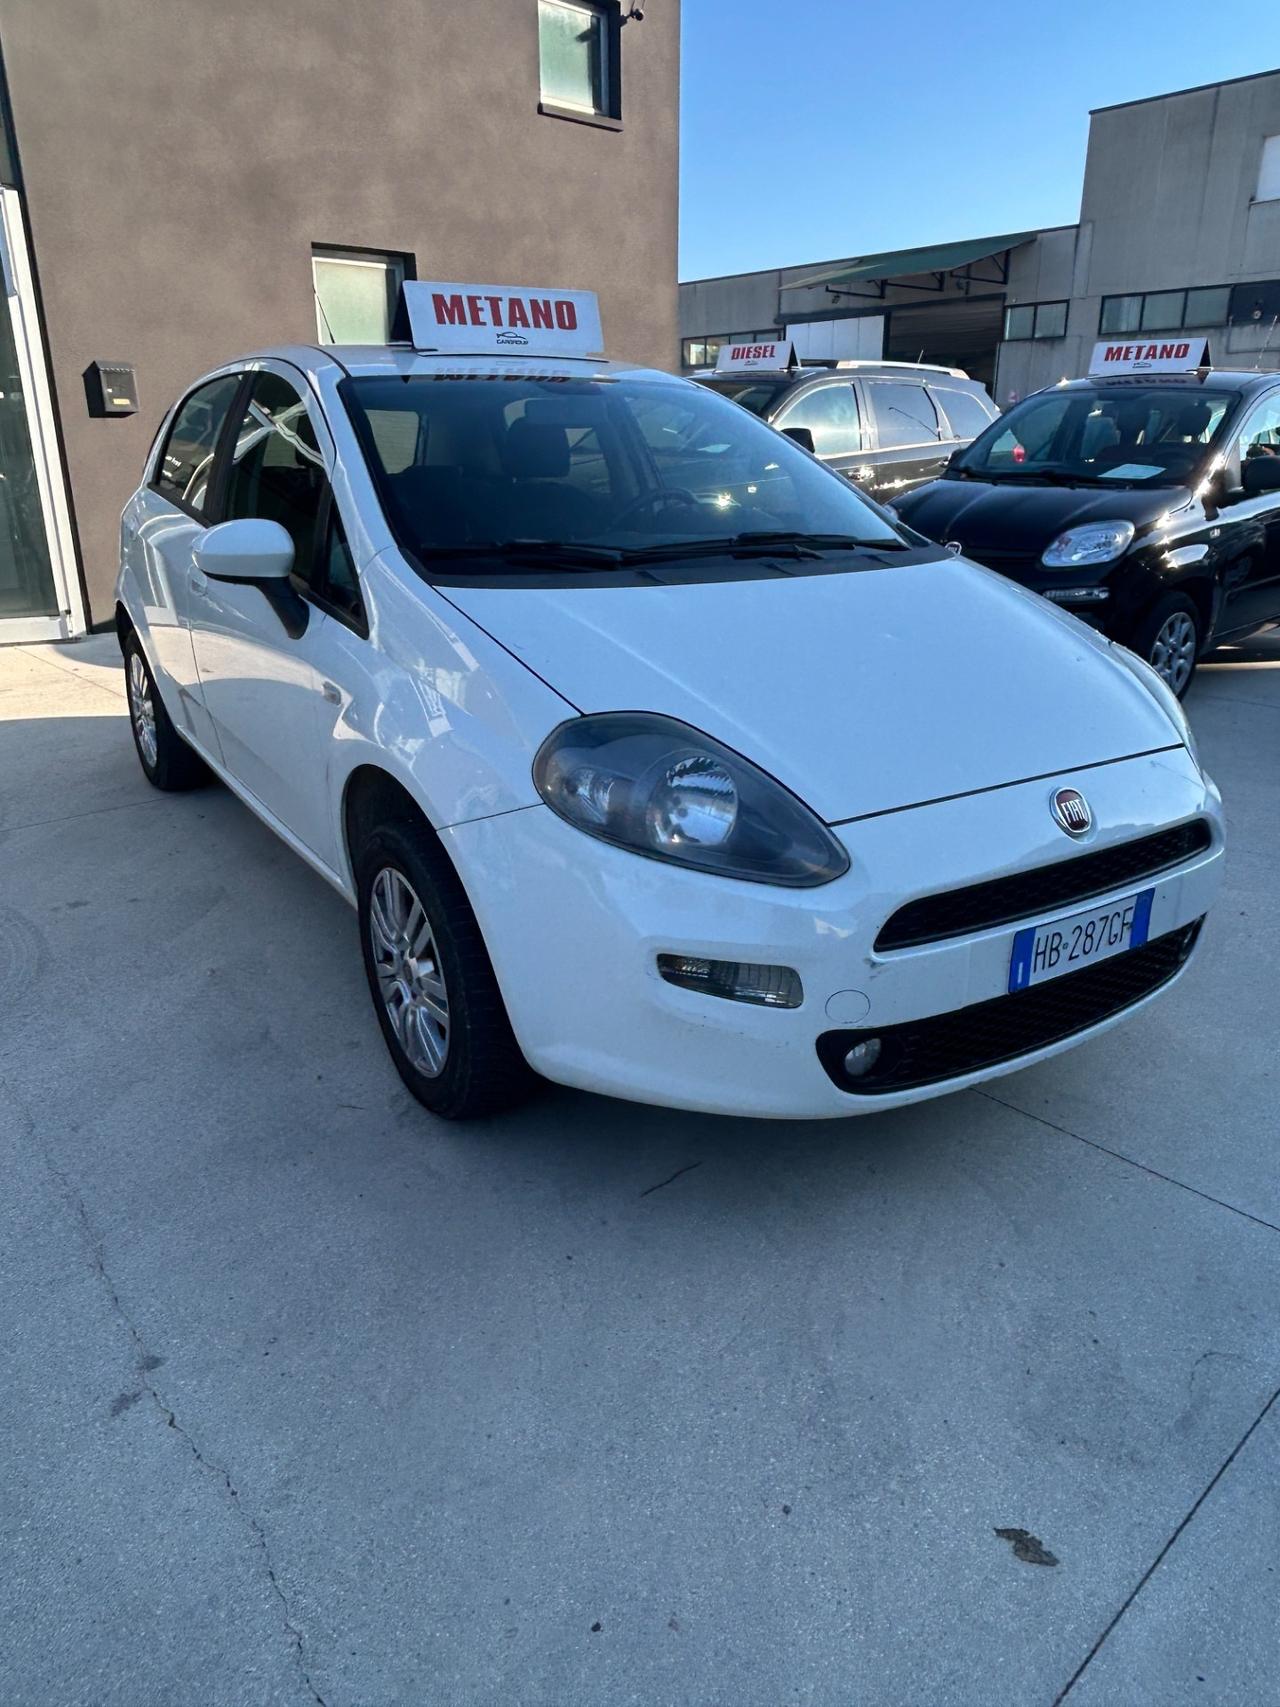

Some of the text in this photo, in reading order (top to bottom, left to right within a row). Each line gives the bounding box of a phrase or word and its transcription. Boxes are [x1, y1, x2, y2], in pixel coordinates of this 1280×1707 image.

[431, 293, 578, 331] METANO
[731, 345, 776, 361] DIESEL
[1104, 343, 1191, 362] METANO
[1060, 798, 1082, 824] FIAT
